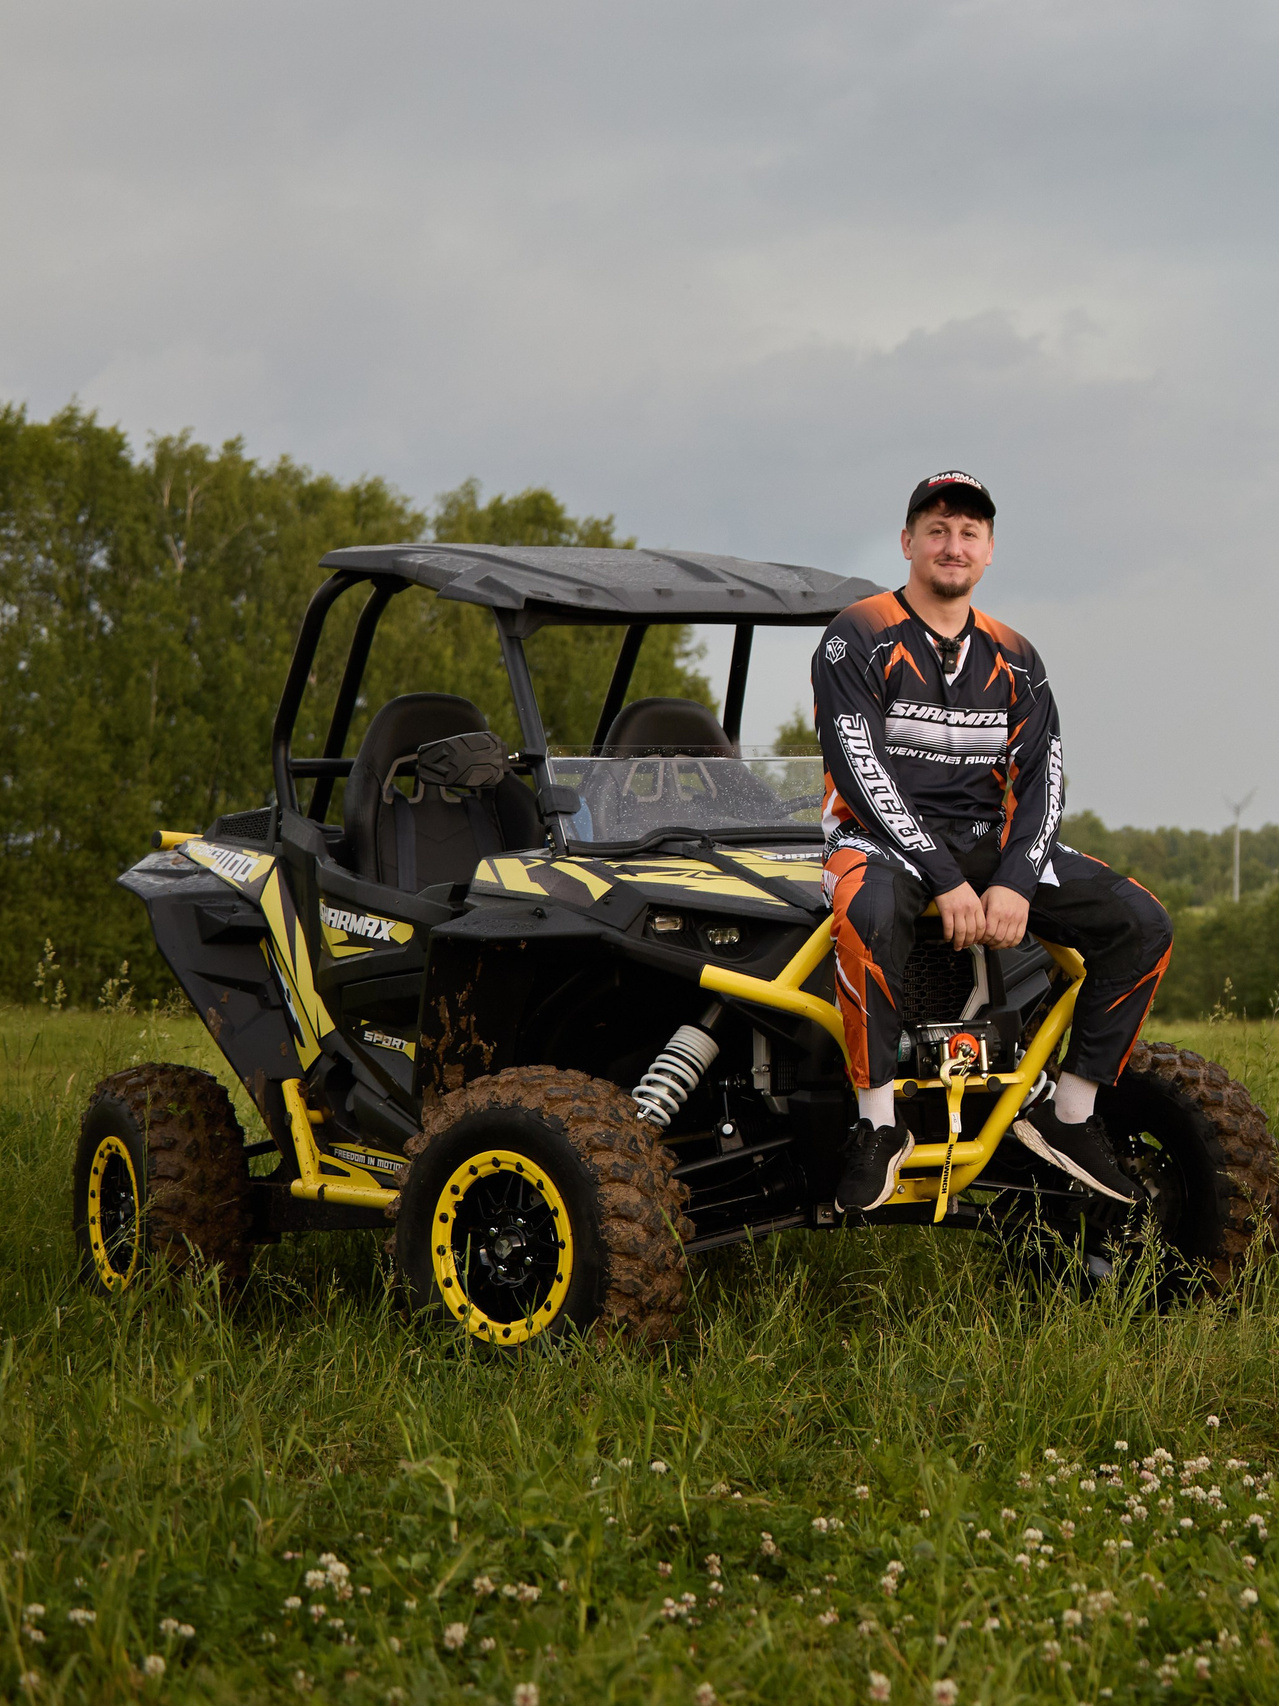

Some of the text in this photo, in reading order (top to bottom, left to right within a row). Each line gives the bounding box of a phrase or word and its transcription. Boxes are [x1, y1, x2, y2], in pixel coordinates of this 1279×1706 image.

[928, 472, 982, 490] SHARMAX
[889, 702, 1008, 726] SHARMAX
[839, 731, 858, 768] RACING
[885, 746, 961, 765] VENTURES
[840, 717, 931, 849] JUSTCAT
[209, 849, 260, 882] 1100
[320, 901, 398, 941] SHARMAX
[364, 1030, 408, 1050] SPORT
[333, 1147, 366, 1164] FREEDOM
[367, 1156, 376, 1166] IN
[941, 1144, 954, 1194] NOVAWINCH
